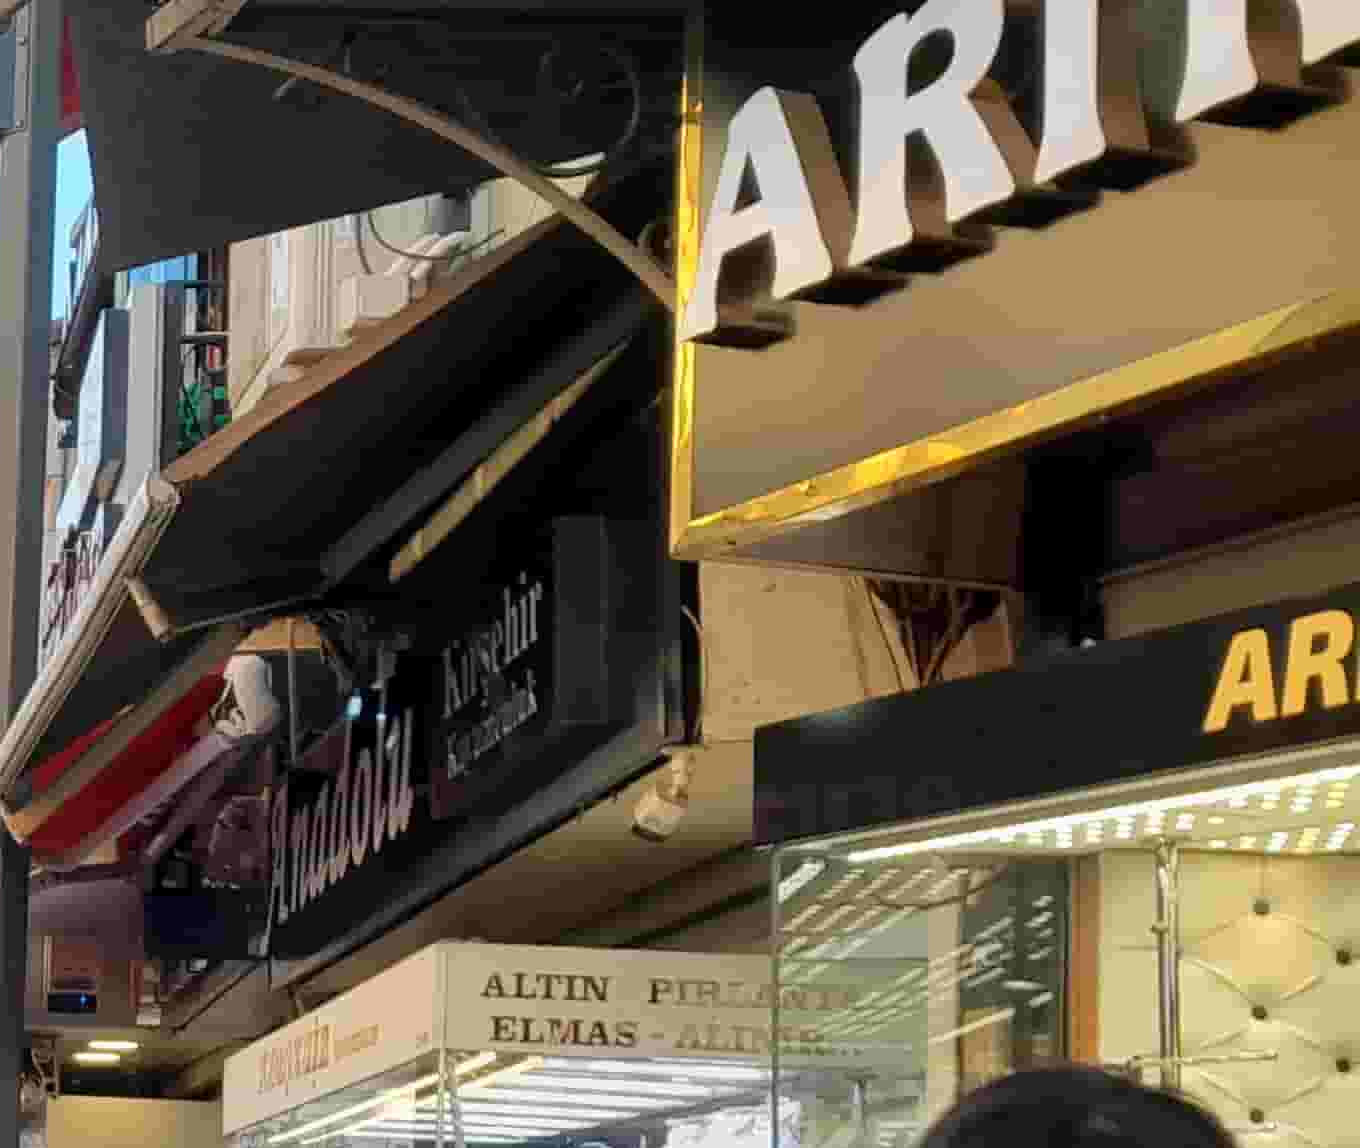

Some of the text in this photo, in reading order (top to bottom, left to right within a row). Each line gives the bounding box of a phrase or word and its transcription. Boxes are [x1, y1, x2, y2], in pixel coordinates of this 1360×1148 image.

[682, 0, 1360, 342] ARI
[1201, 607, 1360, 735] AR
[479, 971, 611, 1003] ALTIN
[488, 1014, 640, 1049] ELMAS
